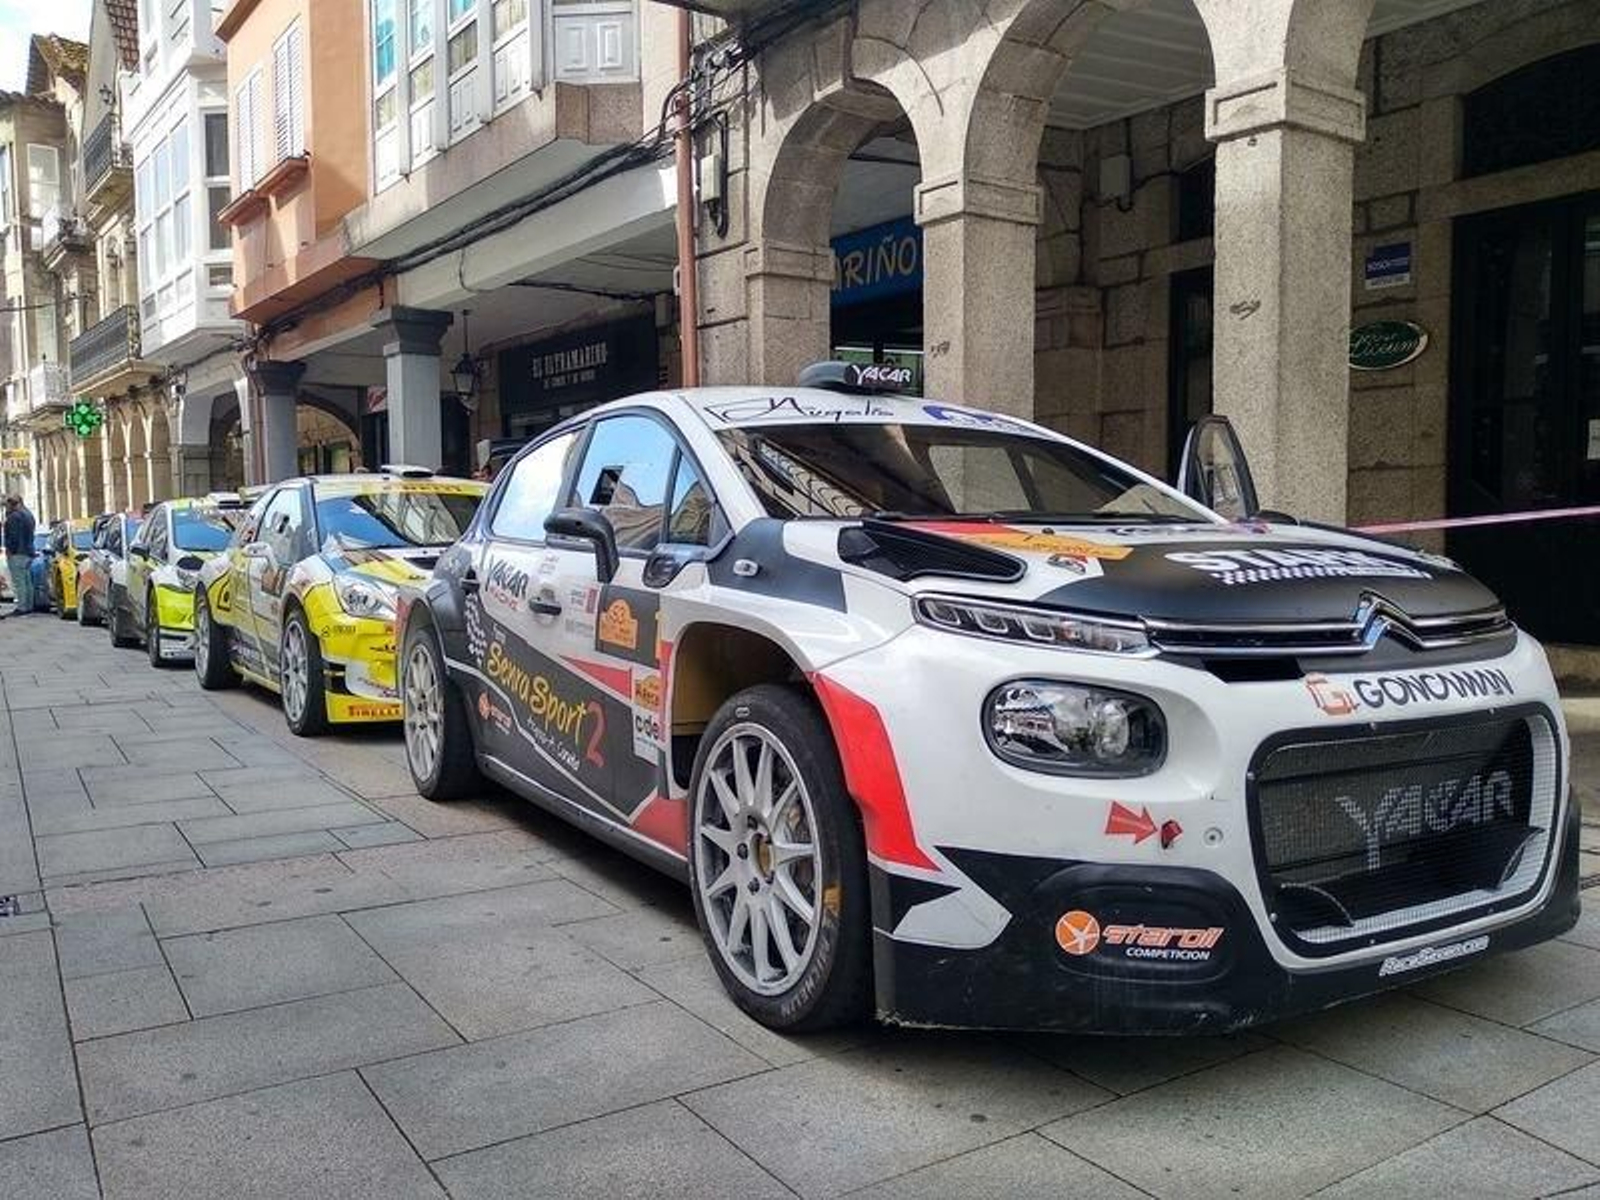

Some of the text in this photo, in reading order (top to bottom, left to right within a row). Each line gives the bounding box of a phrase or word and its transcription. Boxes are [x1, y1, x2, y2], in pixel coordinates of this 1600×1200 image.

[851, 365, 911, 386] YACAR
[1335, 770, 1515, 871] YACAR
[1125, 946, 1211, 961] COMPETICION
